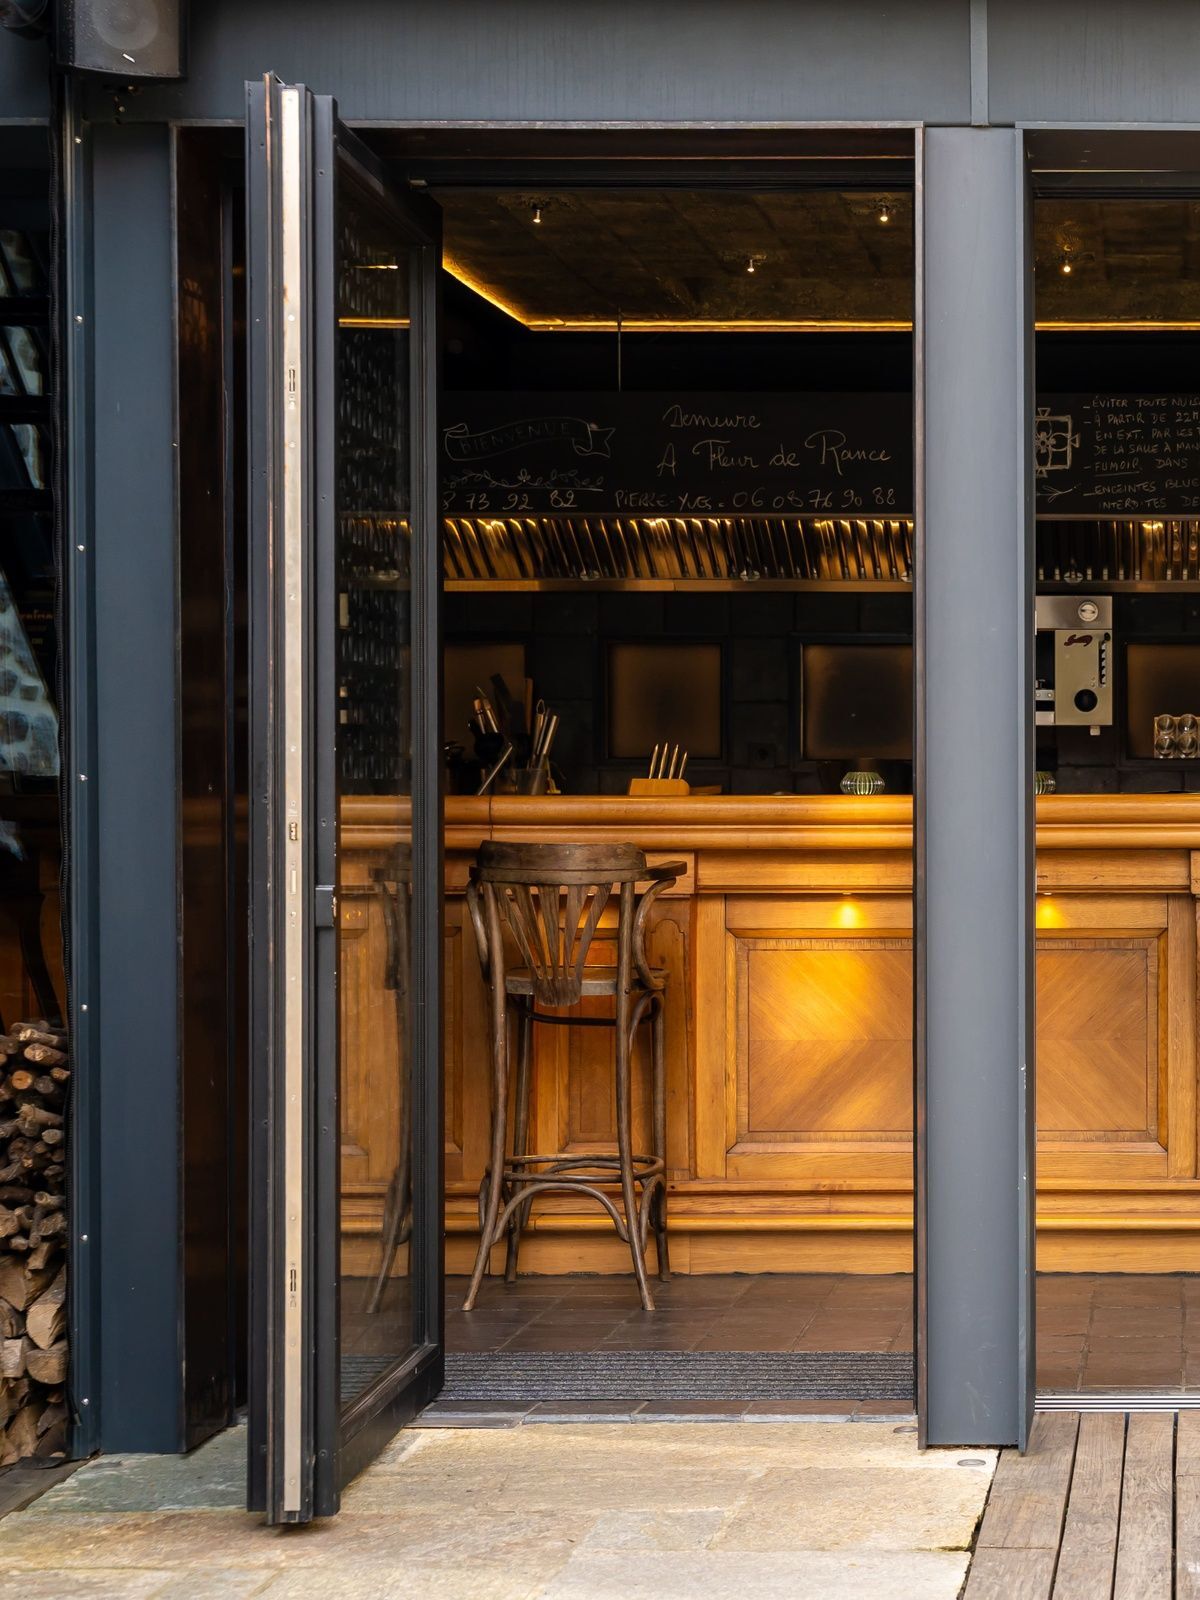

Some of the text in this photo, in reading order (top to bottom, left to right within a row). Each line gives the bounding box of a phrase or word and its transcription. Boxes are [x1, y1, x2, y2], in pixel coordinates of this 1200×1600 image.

[1135, 398, 1168, 408] TOUTE
[662, 404, 761, 429] Demeure
[1107, 412, 1145, 426] PARTIR
[1151, 413, 1167, 424] DE
[459, 422, 569, 455] BIENVENUE
[1096, 430, 1113, 441] EN
[1152, 428, 1170, 439] PAR
[1176, 429, 1193, 438] LES
[656, 429, 892, 478] A Fleur de Rance
[1094, 444, 1107, 456] DE
[1114, 443, 1125, 455] LA
[1129, 443, 1160, 454] SALLE
[1095, 457, 1142, 472] FUMOIR
[1155, 458, 1189, 469] DANS
[1094, 481, 1157, 495] ENCEINTES
[465, 492, 491, 510] 73
[502, 493, 534, 511] 92
[550, 490, 579, 508] 82
[732, 487, 766, 508] 06
[840, 489, 864, 508] 90
[872, 487, 897, 505] 88
[1099, 498, 1169, 511] INTERDITES
